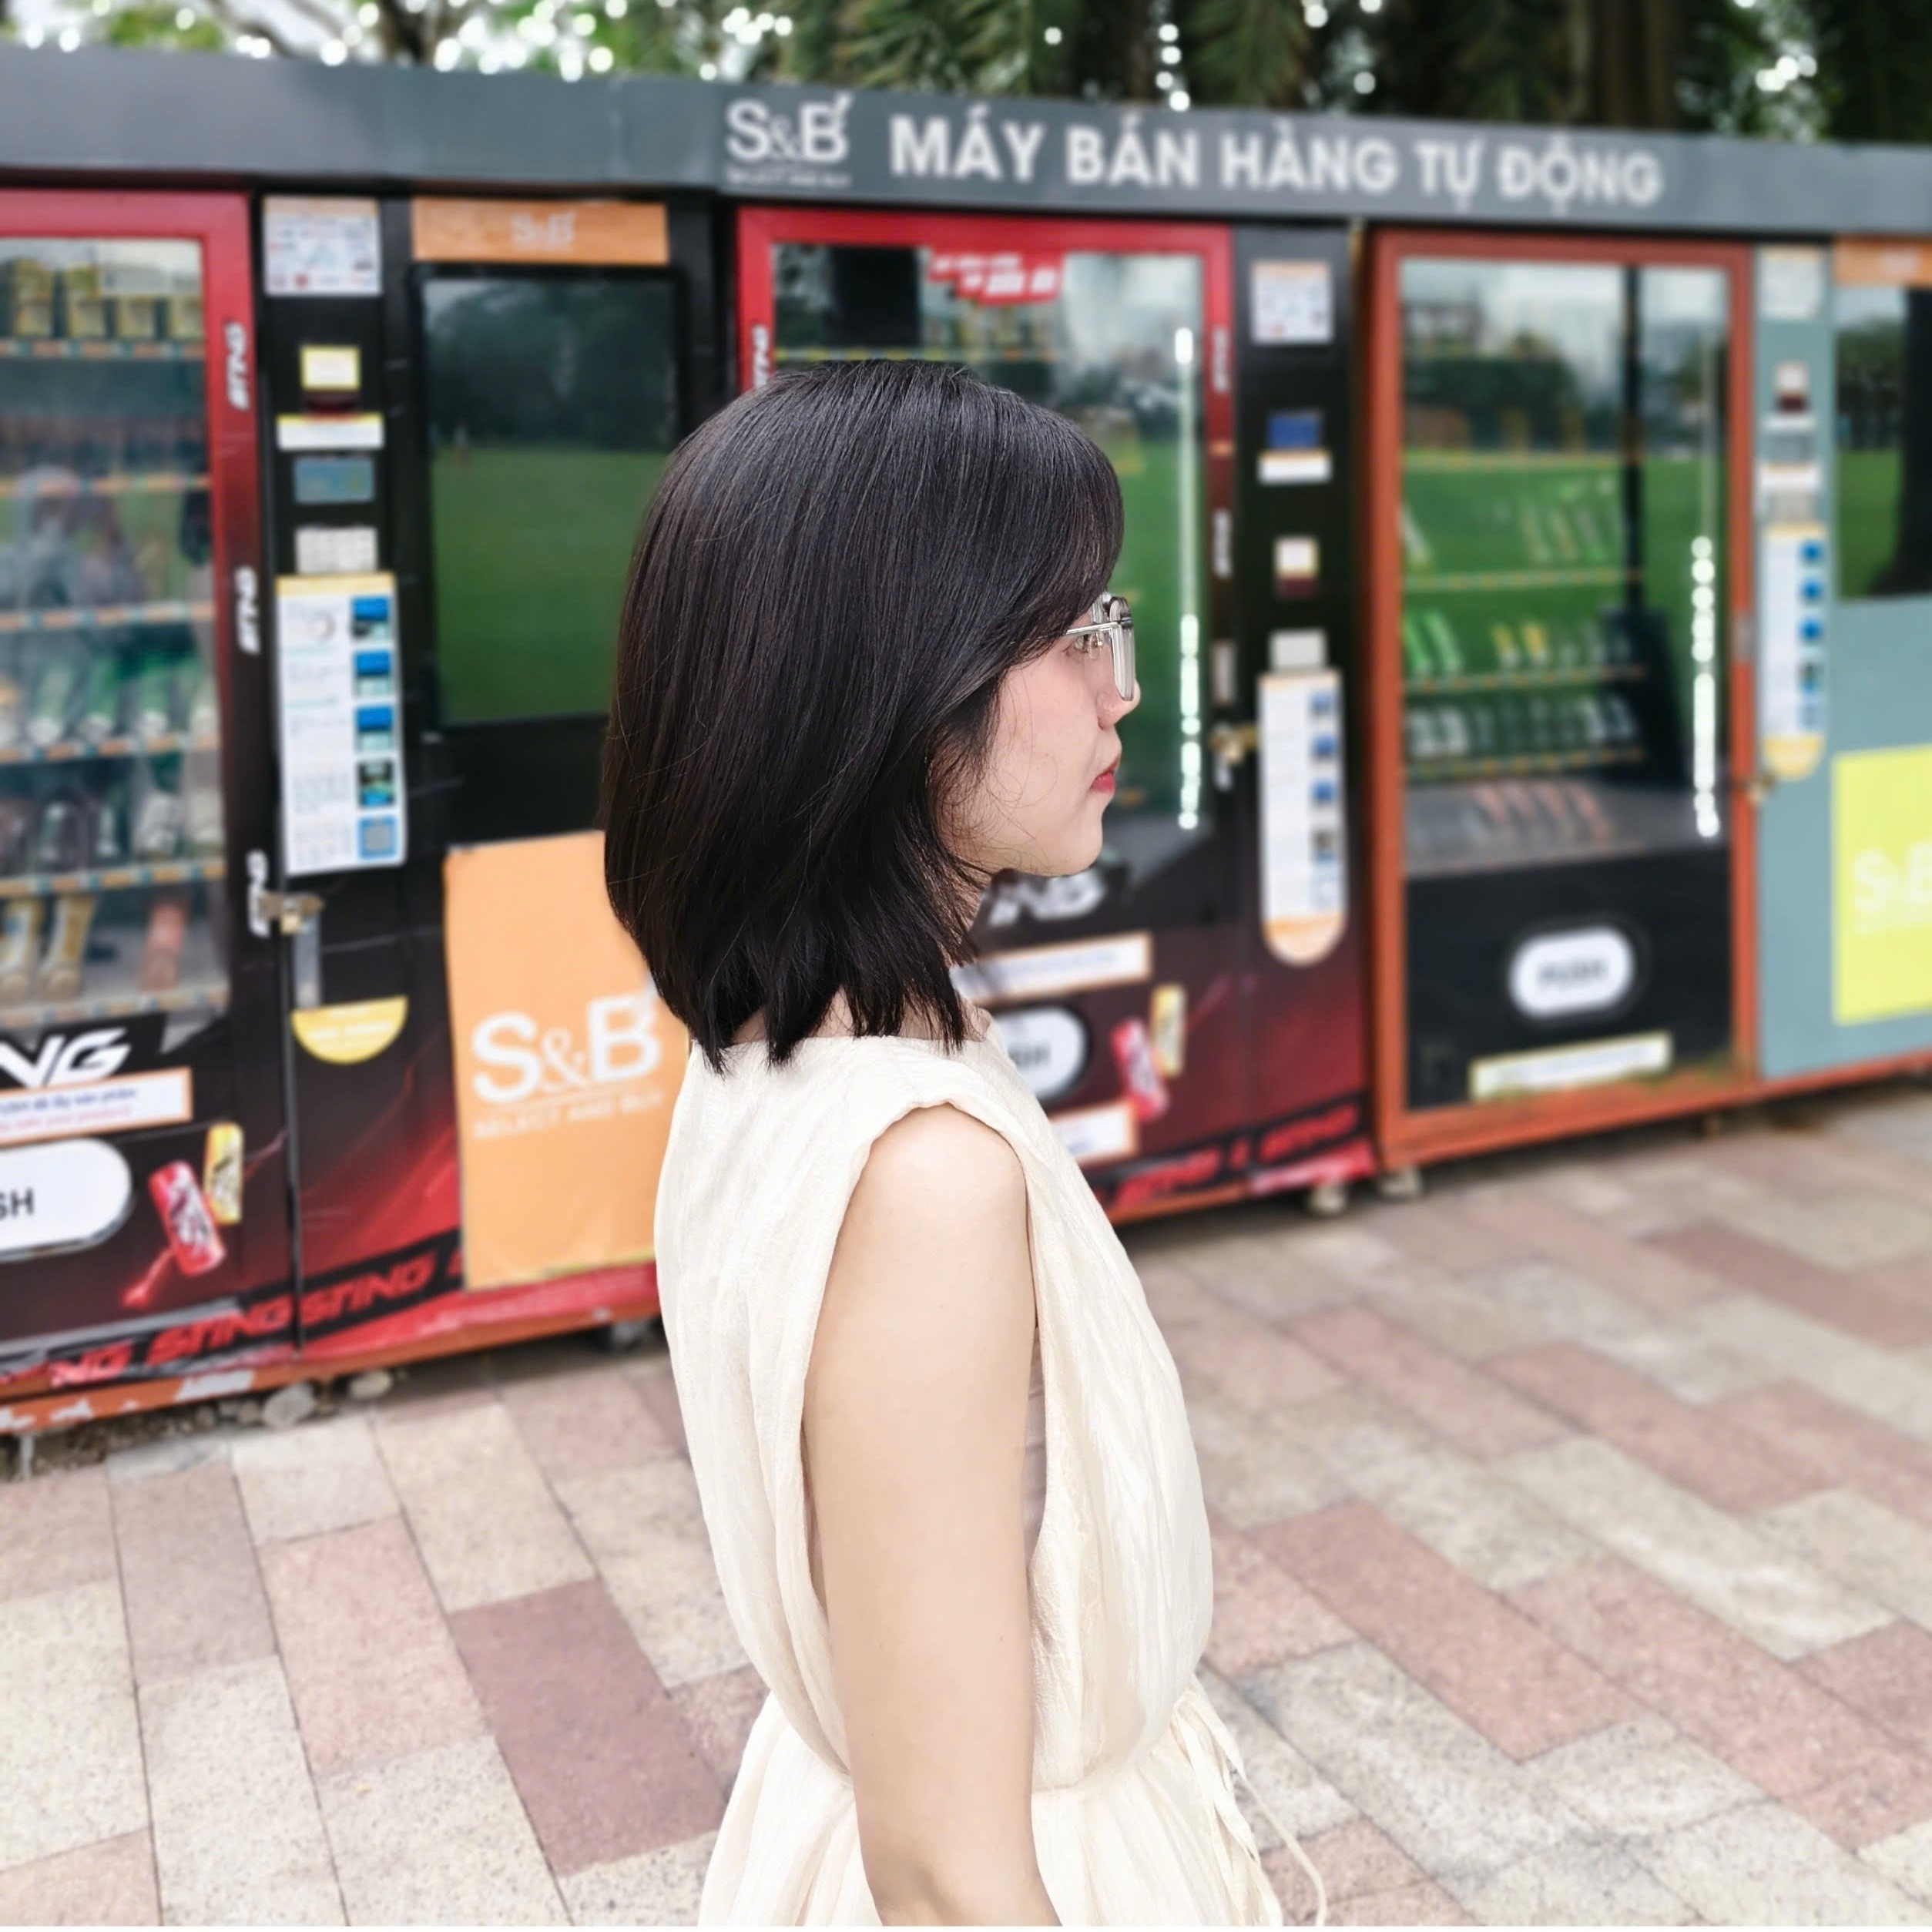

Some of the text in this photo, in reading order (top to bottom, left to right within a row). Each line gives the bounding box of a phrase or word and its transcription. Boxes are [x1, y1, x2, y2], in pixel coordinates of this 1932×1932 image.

[726, 96, 850, 161] S&B
[889, 102, 1664, 216] MÁY BÁN HÀNG TỰ ĐỘNG
[471, 992, 661, 1104] S&B
